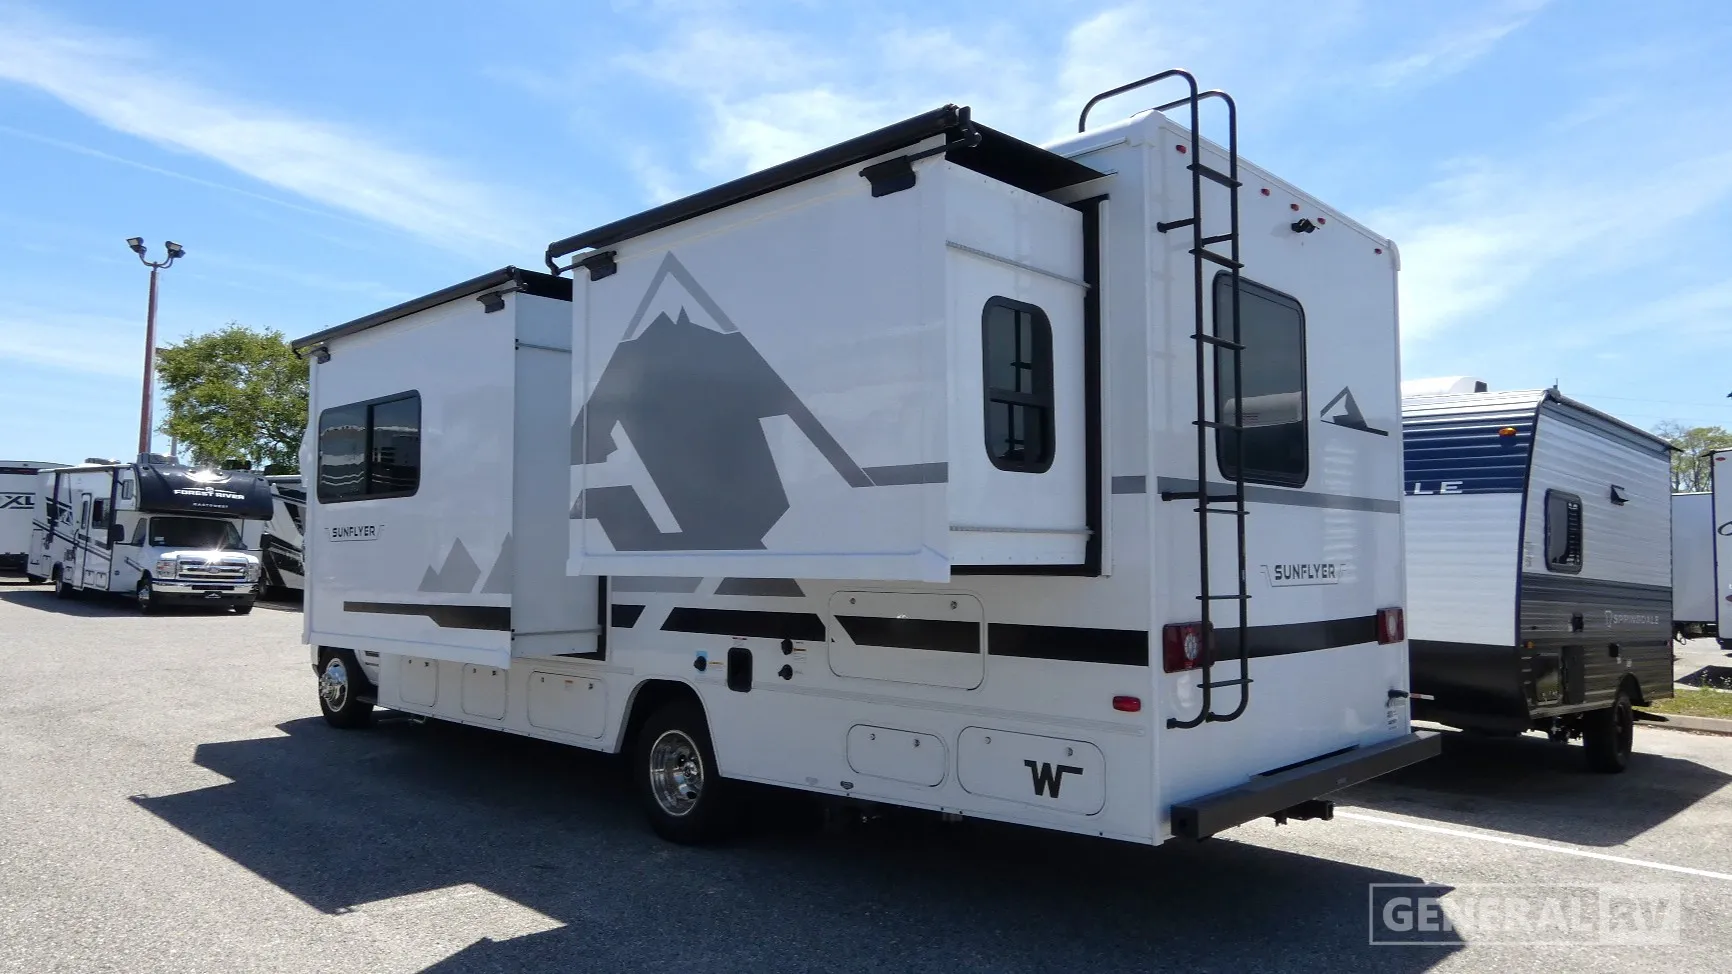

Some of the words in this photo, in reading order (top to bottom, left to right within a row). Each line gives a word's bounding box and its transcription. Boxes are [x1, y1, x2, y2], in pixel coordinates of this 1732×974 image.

[173, 489, 215, 497] FOREST
[215, 492, 245, 500] RIVER
[1403, 481, 1463, 495] LE
[332, 525, 376, 538] SUNFLYER
[1274, 563, 1336, 581] SUNFLYER
